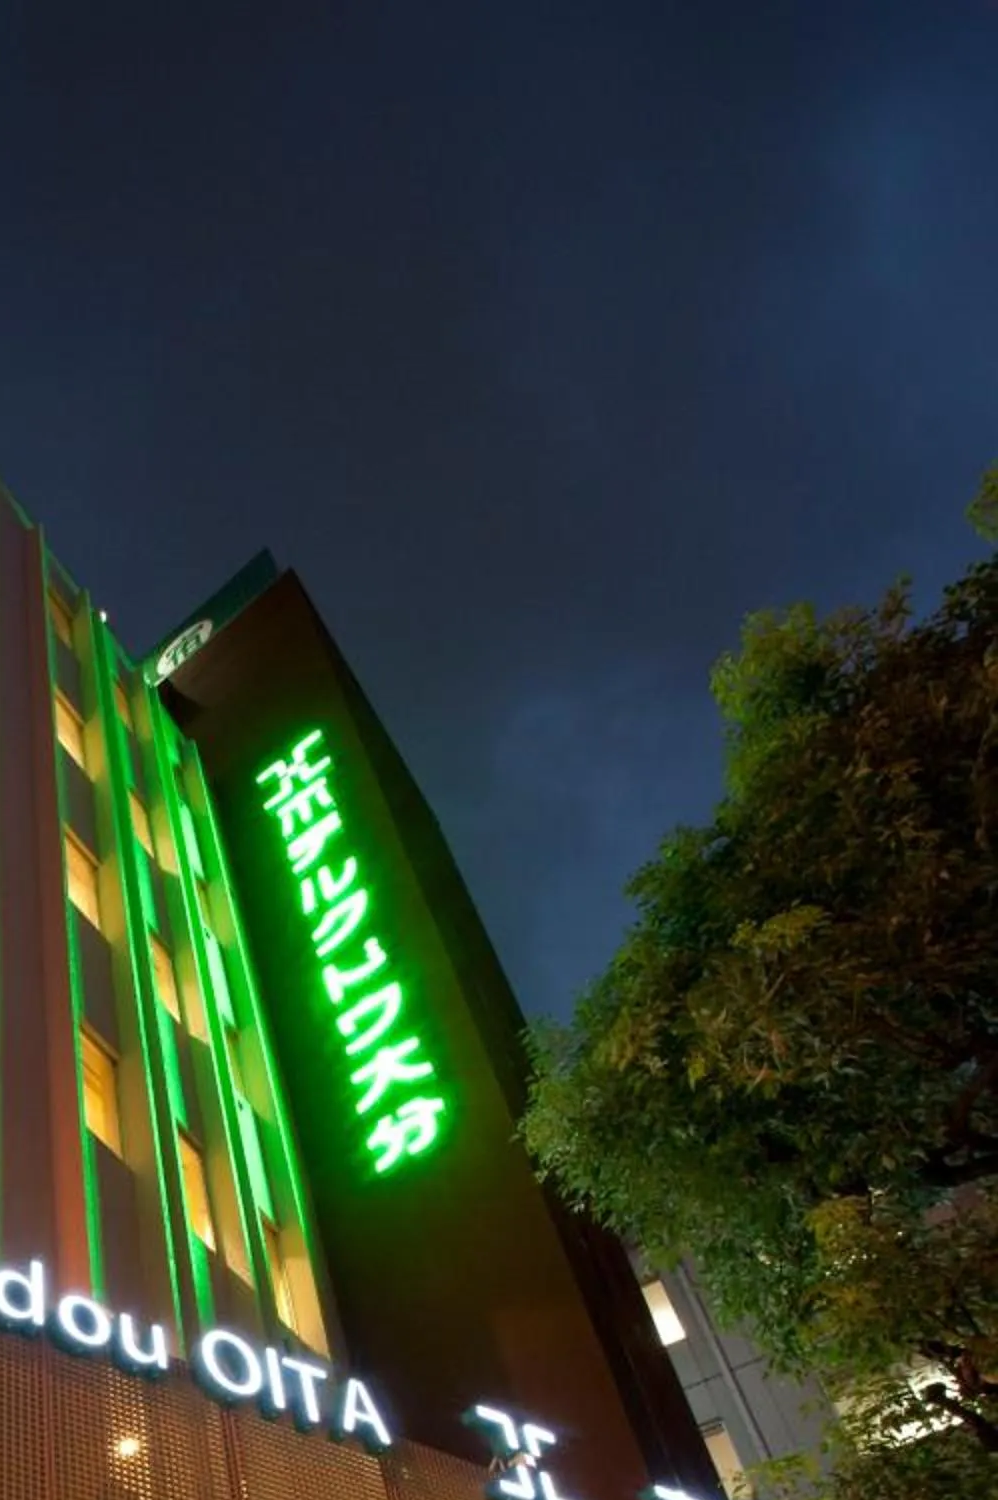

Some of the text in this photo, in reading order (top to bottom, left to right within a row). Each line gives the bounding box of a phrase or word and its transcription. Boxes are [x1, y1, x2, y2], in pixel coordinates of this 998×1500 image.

[276, 776, 445, 1174] ホテルクドウ大分
[201, 1328, 392, 1446] OITA
